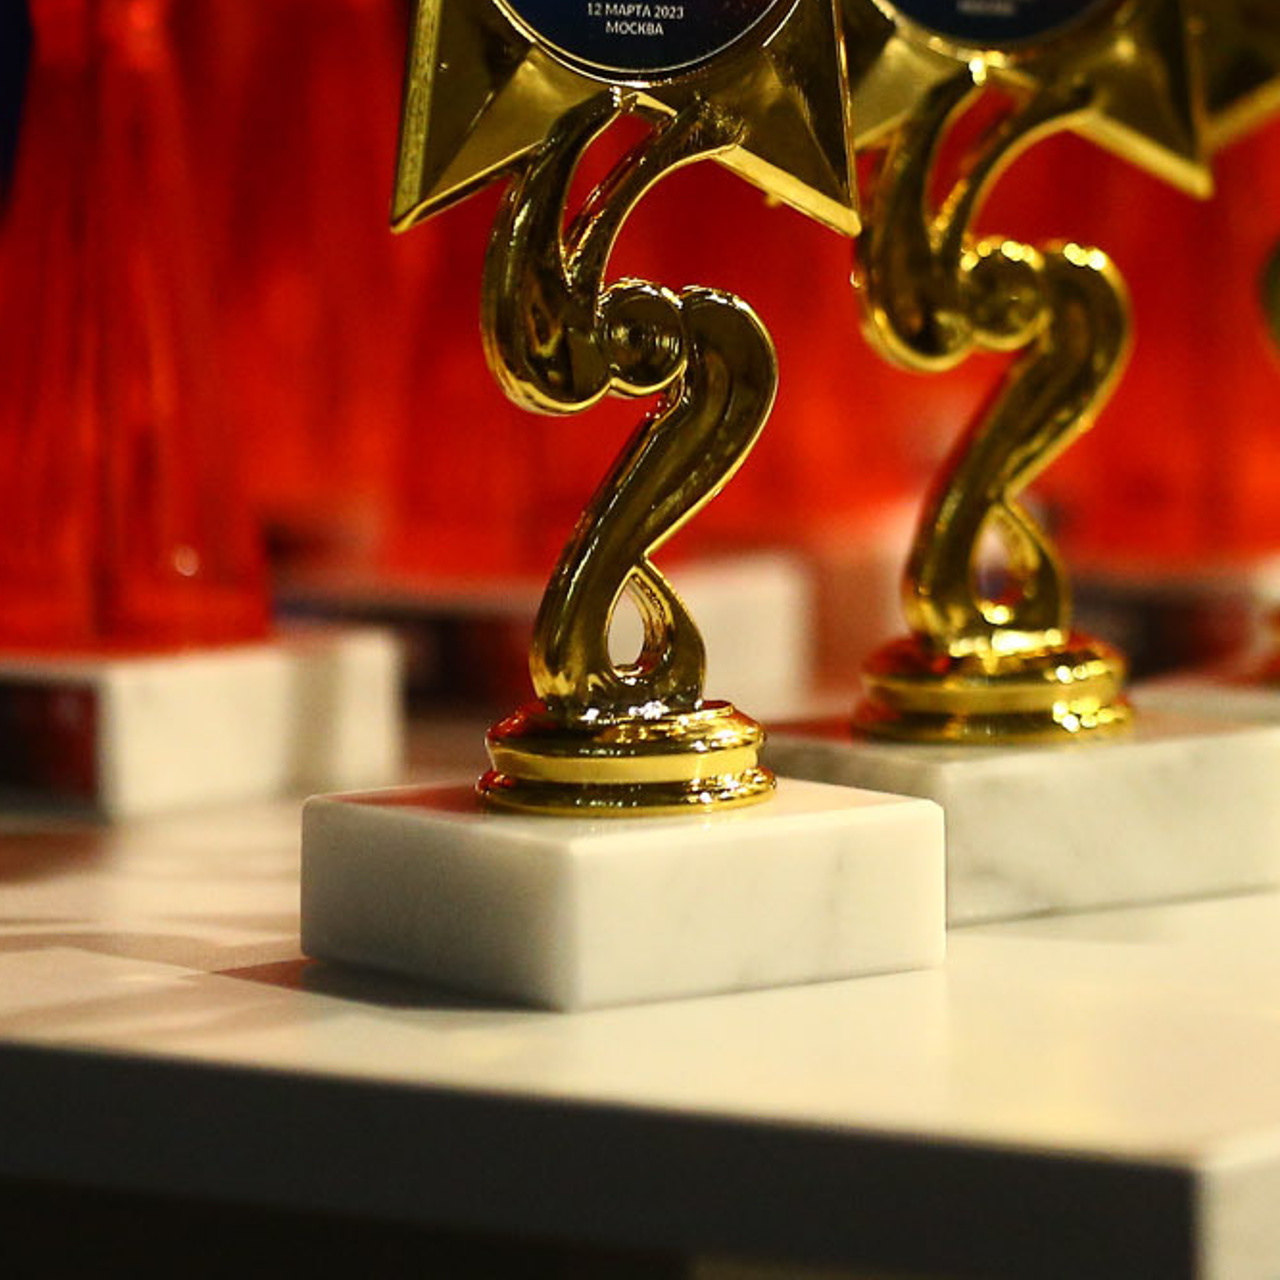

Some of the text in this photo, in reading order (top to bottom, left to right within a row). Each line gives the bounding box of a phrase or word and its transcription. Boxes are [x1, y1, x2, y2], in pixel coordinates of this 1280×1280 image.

[587, 2, 685, 19] 12 МАРТА 2023
[605, 21, 664, 36] МОСКВА
